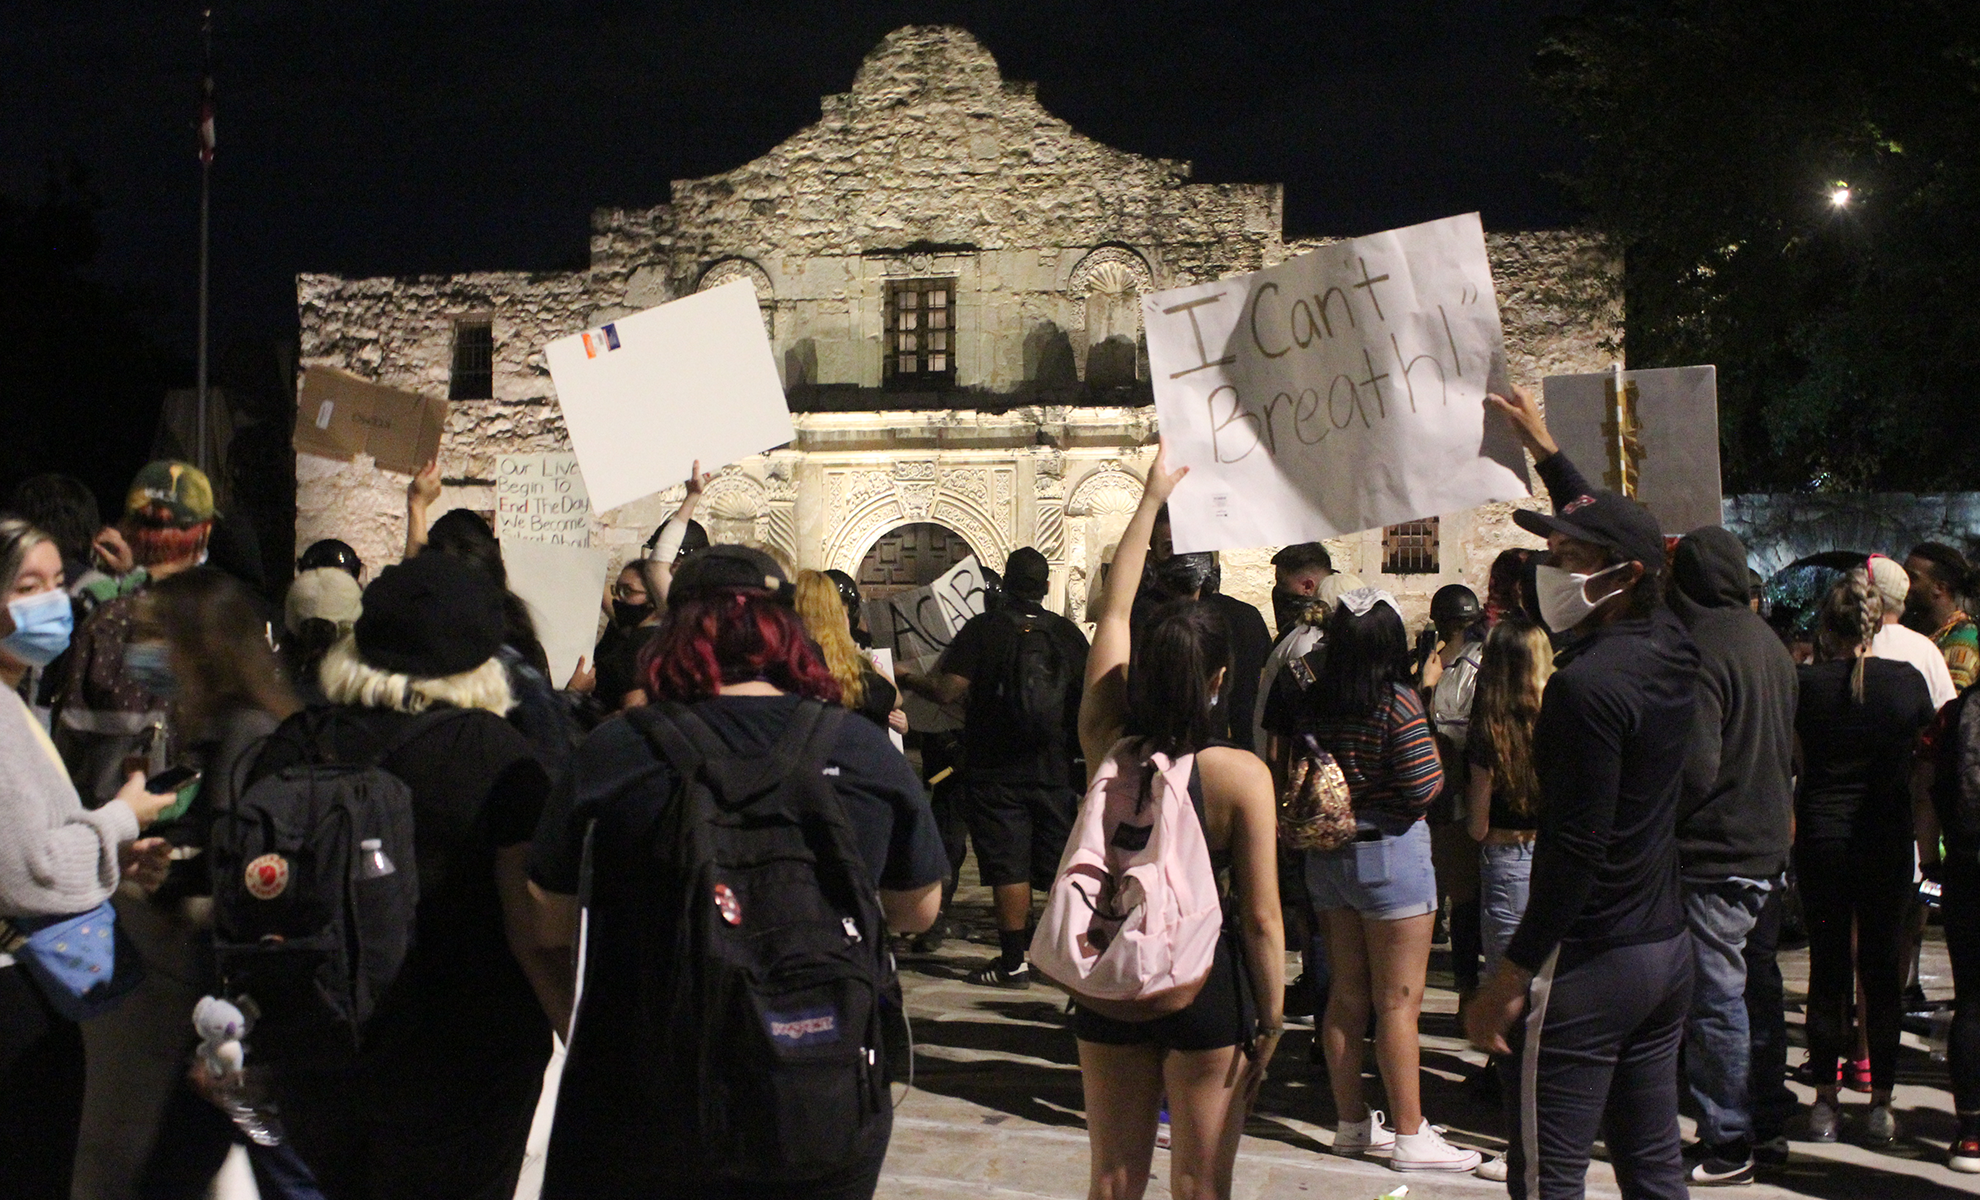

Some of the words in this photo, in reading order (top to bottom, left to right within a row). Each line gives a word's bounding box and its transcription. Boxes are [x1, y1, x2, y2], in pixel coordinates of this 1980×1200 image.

[501, 457, 531, 475] Our
[542, 458, 582, 477] Live
[498, 476, 543, 498] Begin
[551, 477, 571, 493] To
[499, 496, 528, 514] End
[534, 497, 559, 514] The
[561, 495, 590, 516] Day
[501, 514, 525, 529] We
[531, 515, 586, 532] Become
[889, 569, 986, 661] ACAB
